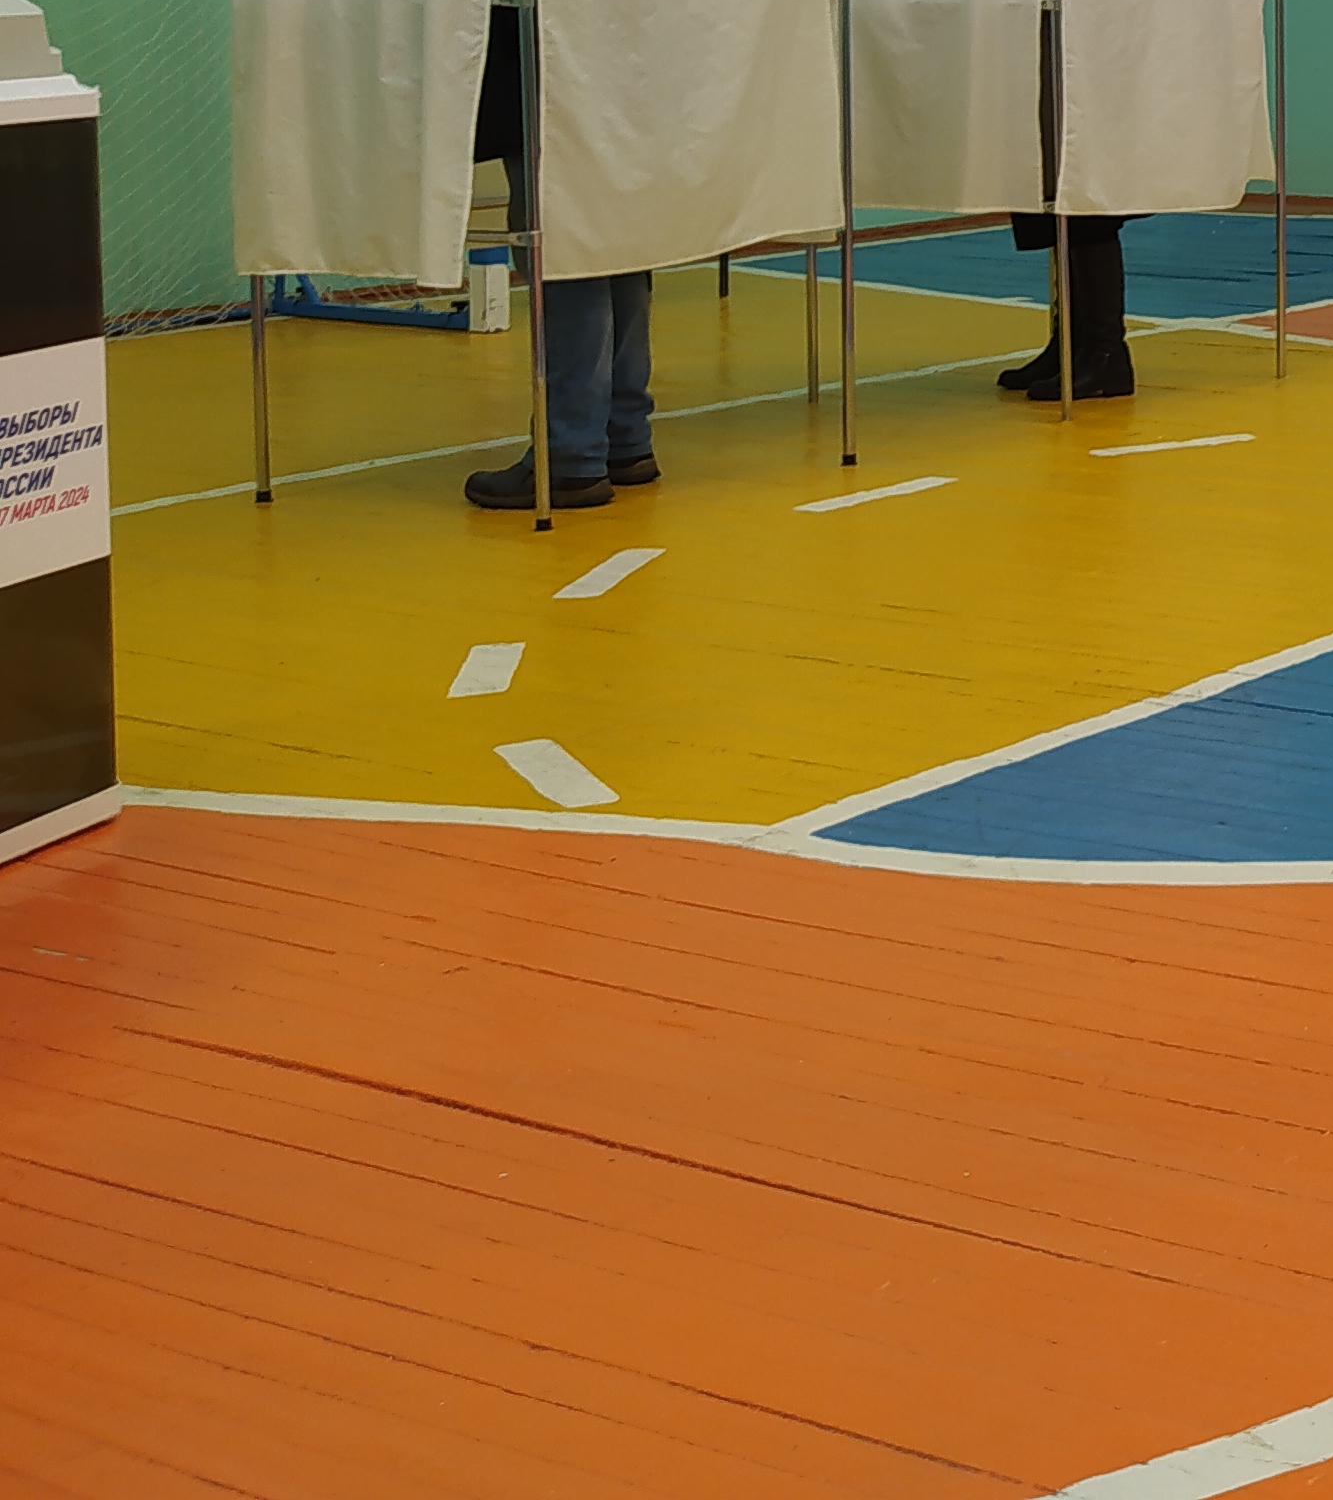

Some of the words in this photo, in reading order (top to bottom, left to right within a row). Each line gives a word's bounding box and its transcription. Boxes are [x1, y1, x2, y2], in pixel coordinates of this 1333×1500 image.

[0, 400, 80, 439] ВЫБОРЫ
[0, 424, 104, 470] РЕЗИДЕНТА
[9, 493, 56, 525] МАРТА
[56, 485, 90, 512] 2024
